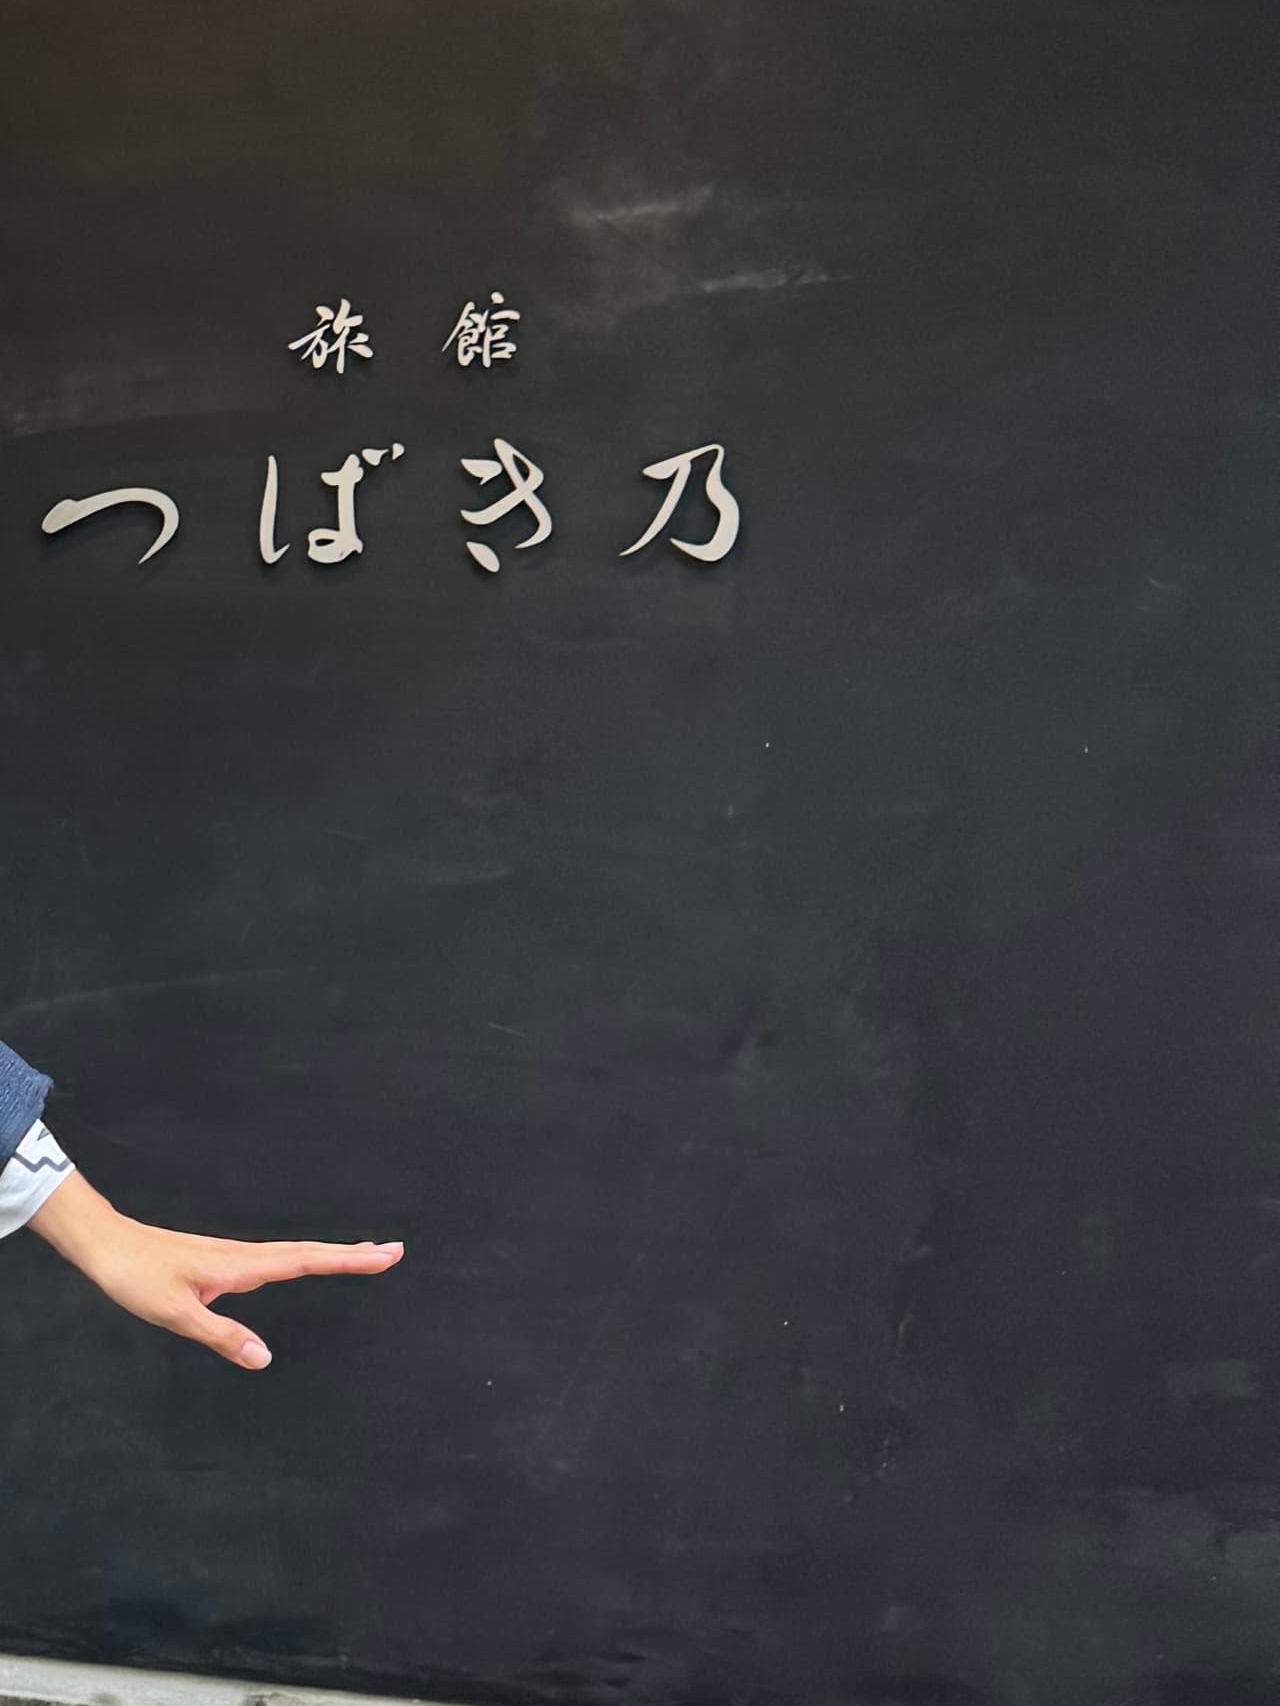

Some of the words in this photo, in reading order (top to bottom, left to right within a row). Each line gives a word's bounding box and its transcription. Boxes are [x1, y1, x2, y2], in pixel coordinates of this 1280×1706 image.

[287, 291, 521, 374] 旅館
[41, 438, 740, 573] つばき乃
